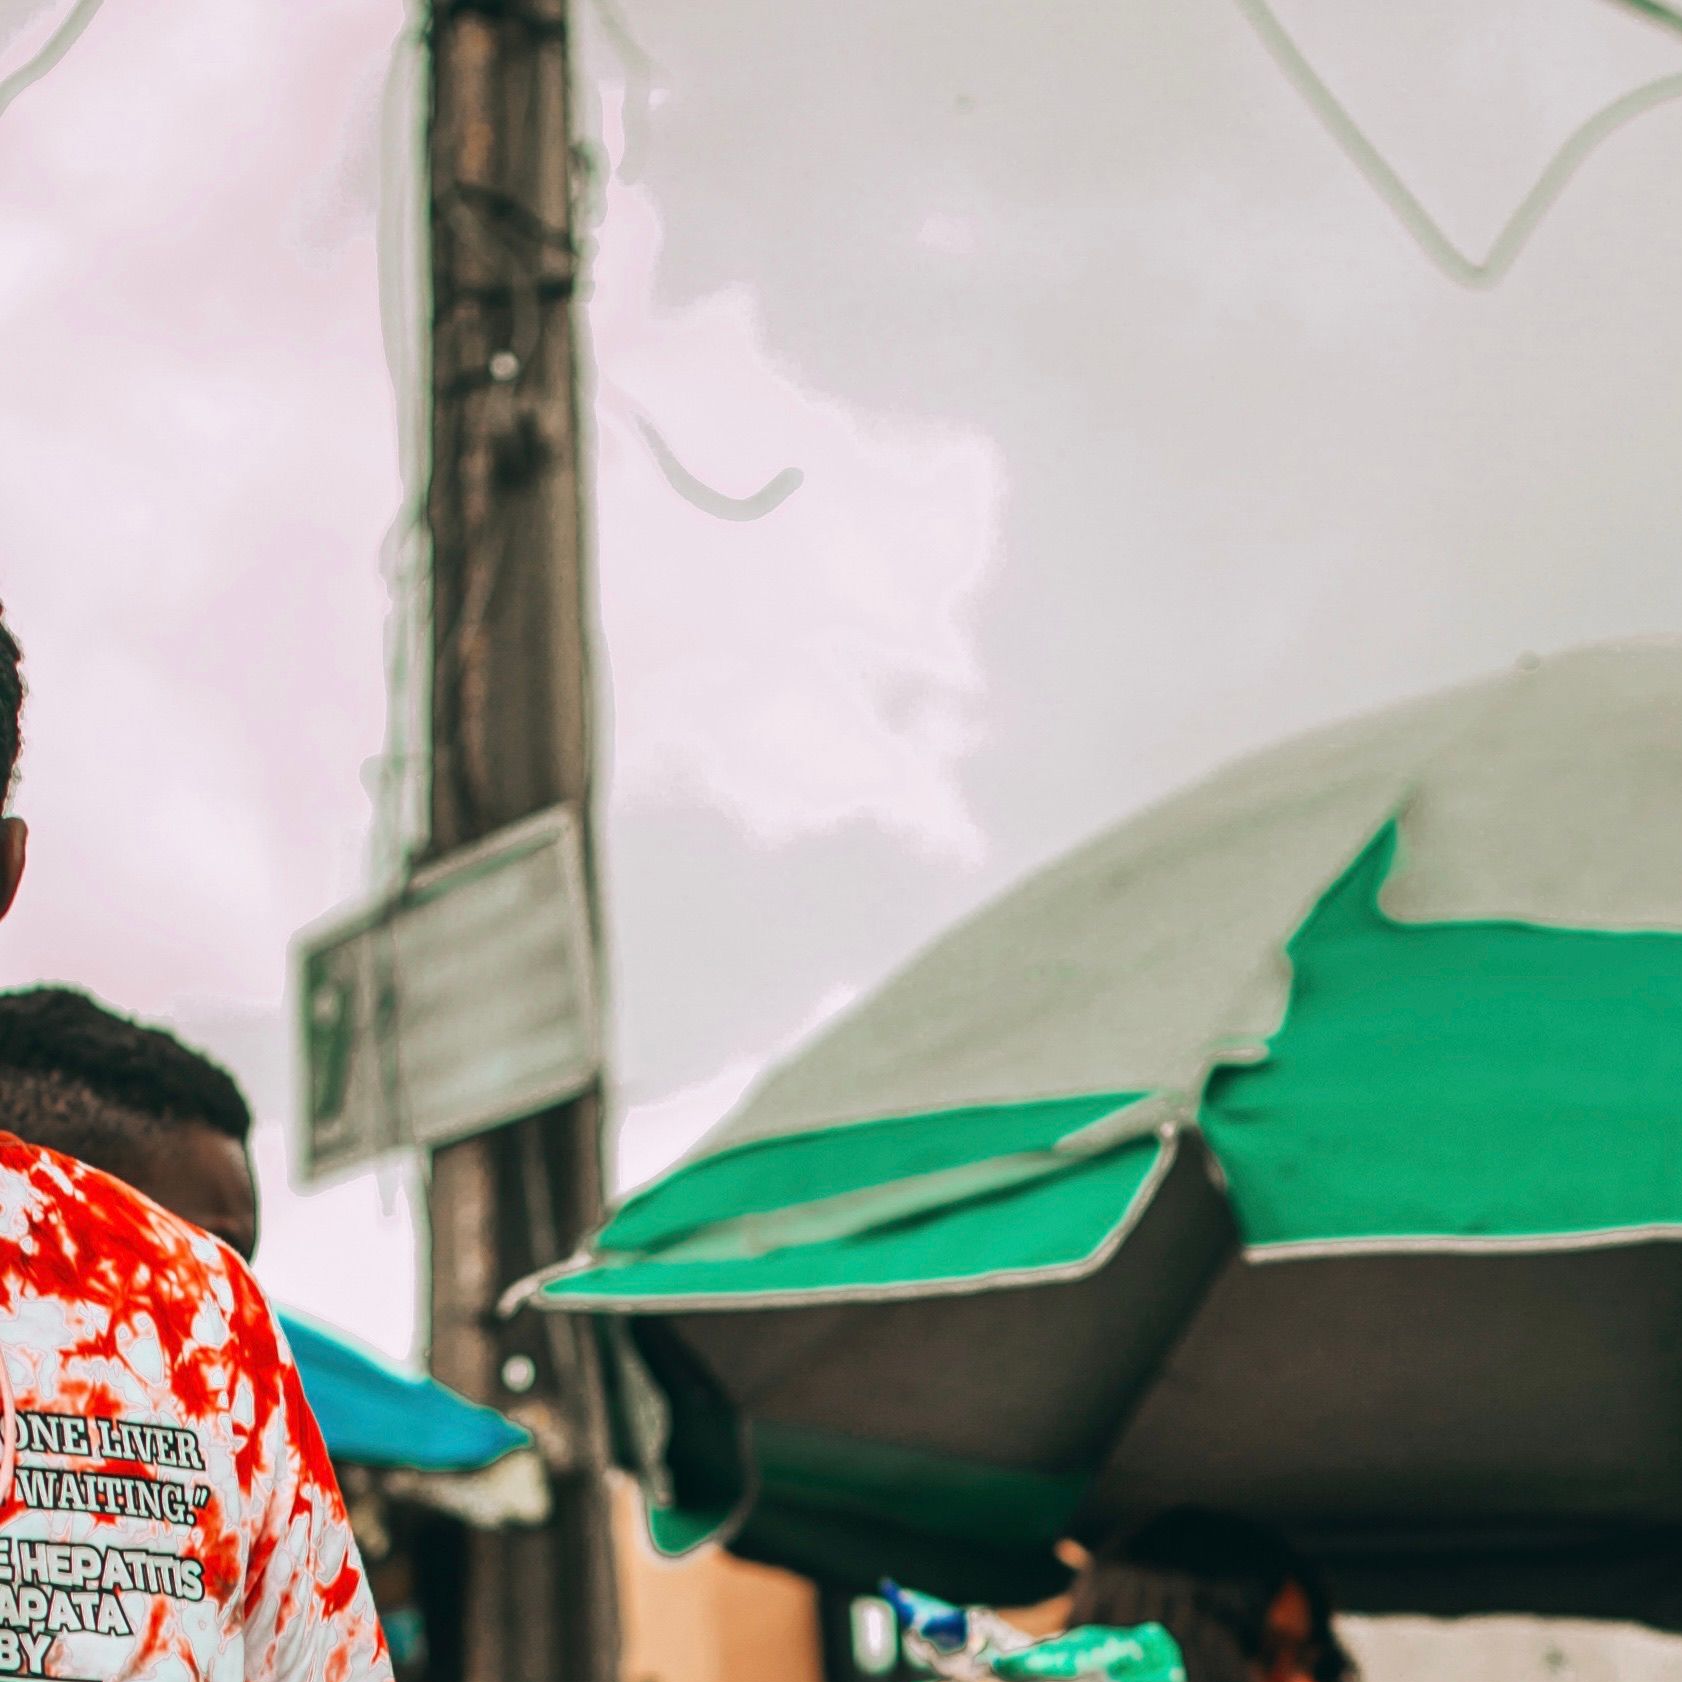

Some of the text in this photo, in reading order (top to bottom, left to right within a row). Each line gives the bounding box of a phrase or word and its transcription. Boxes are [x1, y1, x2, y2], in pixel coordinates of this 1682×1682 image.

[97, 1418, 205, 1470] LIVER
[18, 1540, 205, 1601] HEPATITIS
[0, 1628, 55, 1675] BY
